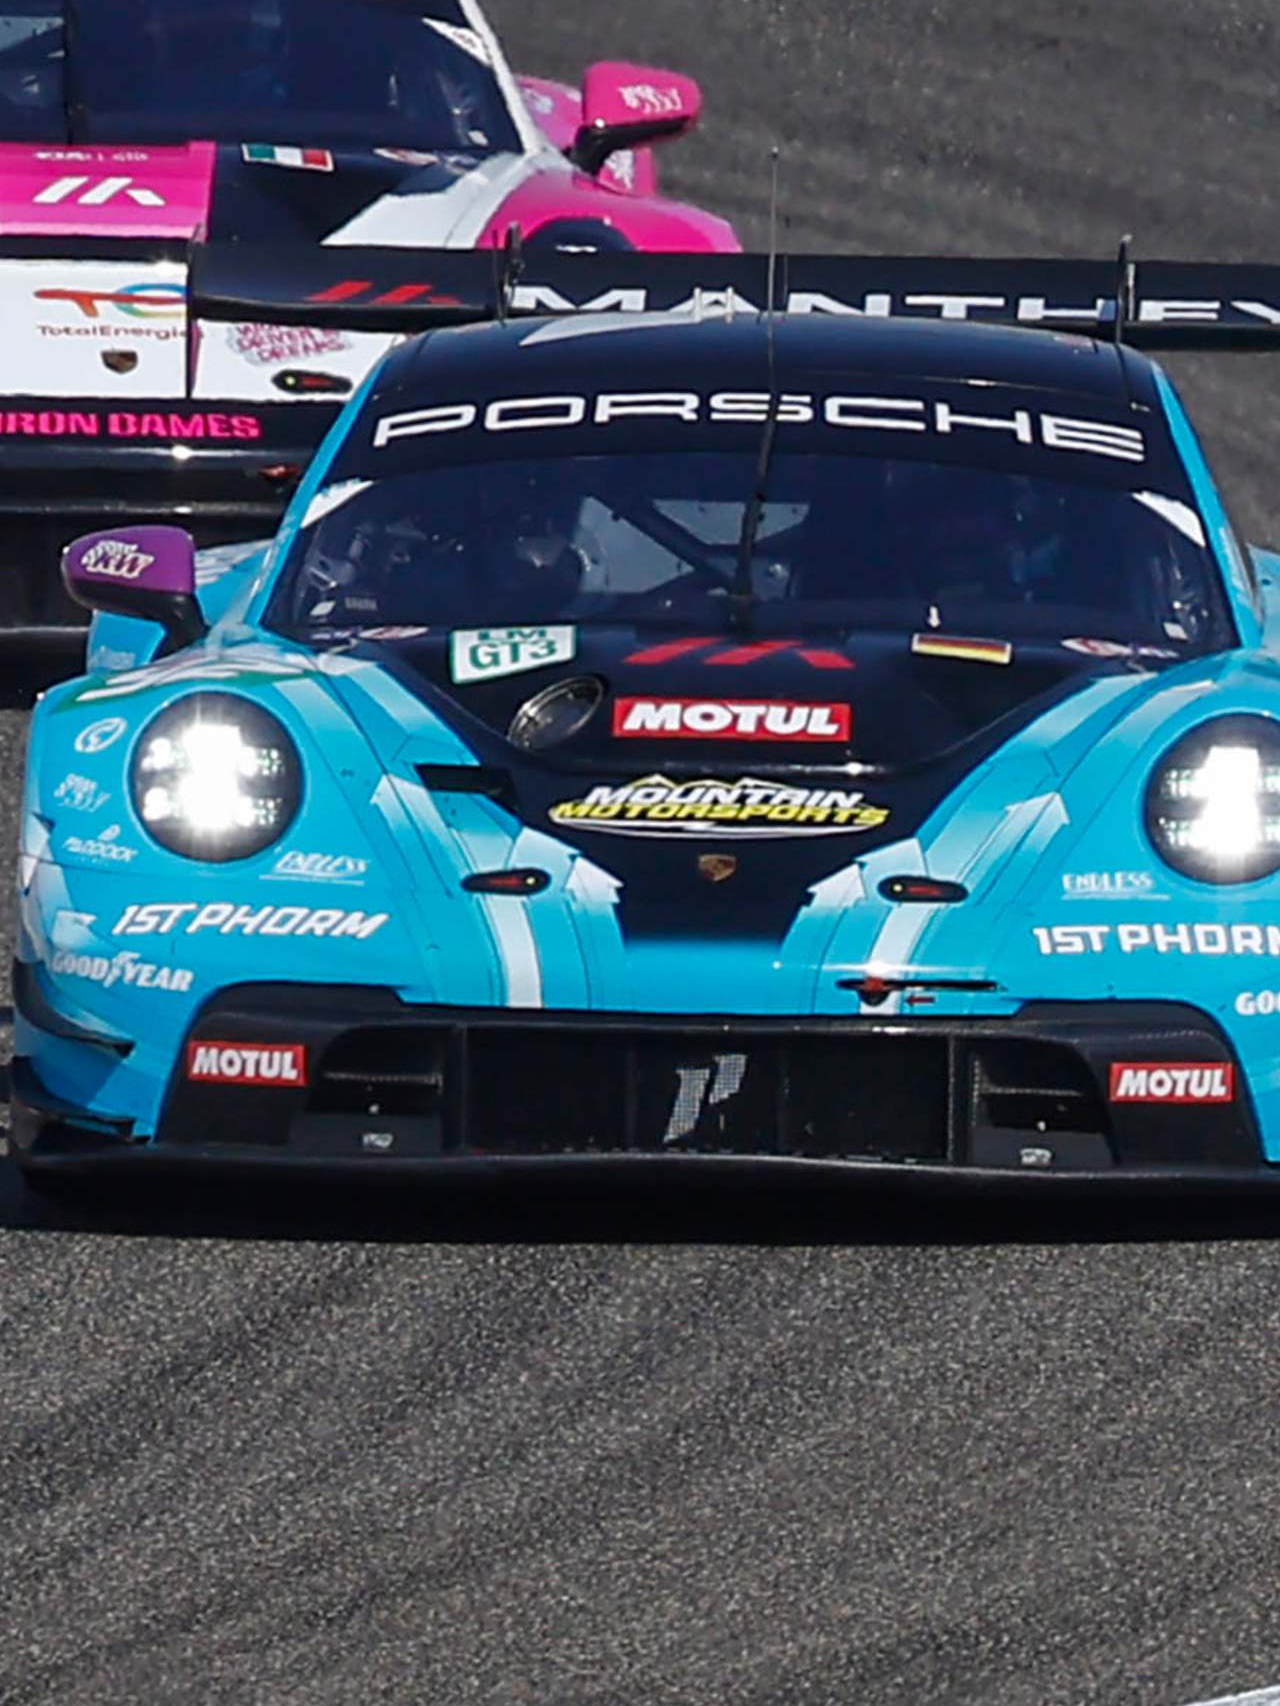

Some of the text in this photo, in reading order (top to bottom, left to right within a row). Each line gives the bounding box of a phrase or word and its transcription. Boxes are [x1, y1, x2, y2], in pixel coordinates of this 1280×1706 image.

[35, 324, 204, 341] TotalEnergi
[107, 413, 262, 439] DAMES
[372, 392, 1145, 462] PORSCHE
[468, 638, 559, 671] GT3
[622, 701, 840, 736] MOTUL
[582, 785, 864, 809] MOUNTAIN
[554, 801, 890, 826] MOTORSPORTS
[1061, 871, 1155, 891] ENDLESS
[111, 902, 390, 940] 1ST PHORM
[1032, 924, 1110, 955] 1ST
[50, 950, 195, 993] GOODYEAR
[191, 1045, 299, 1081] MOTUL
[1115, 1068, 1228, 1099] MOTUL
